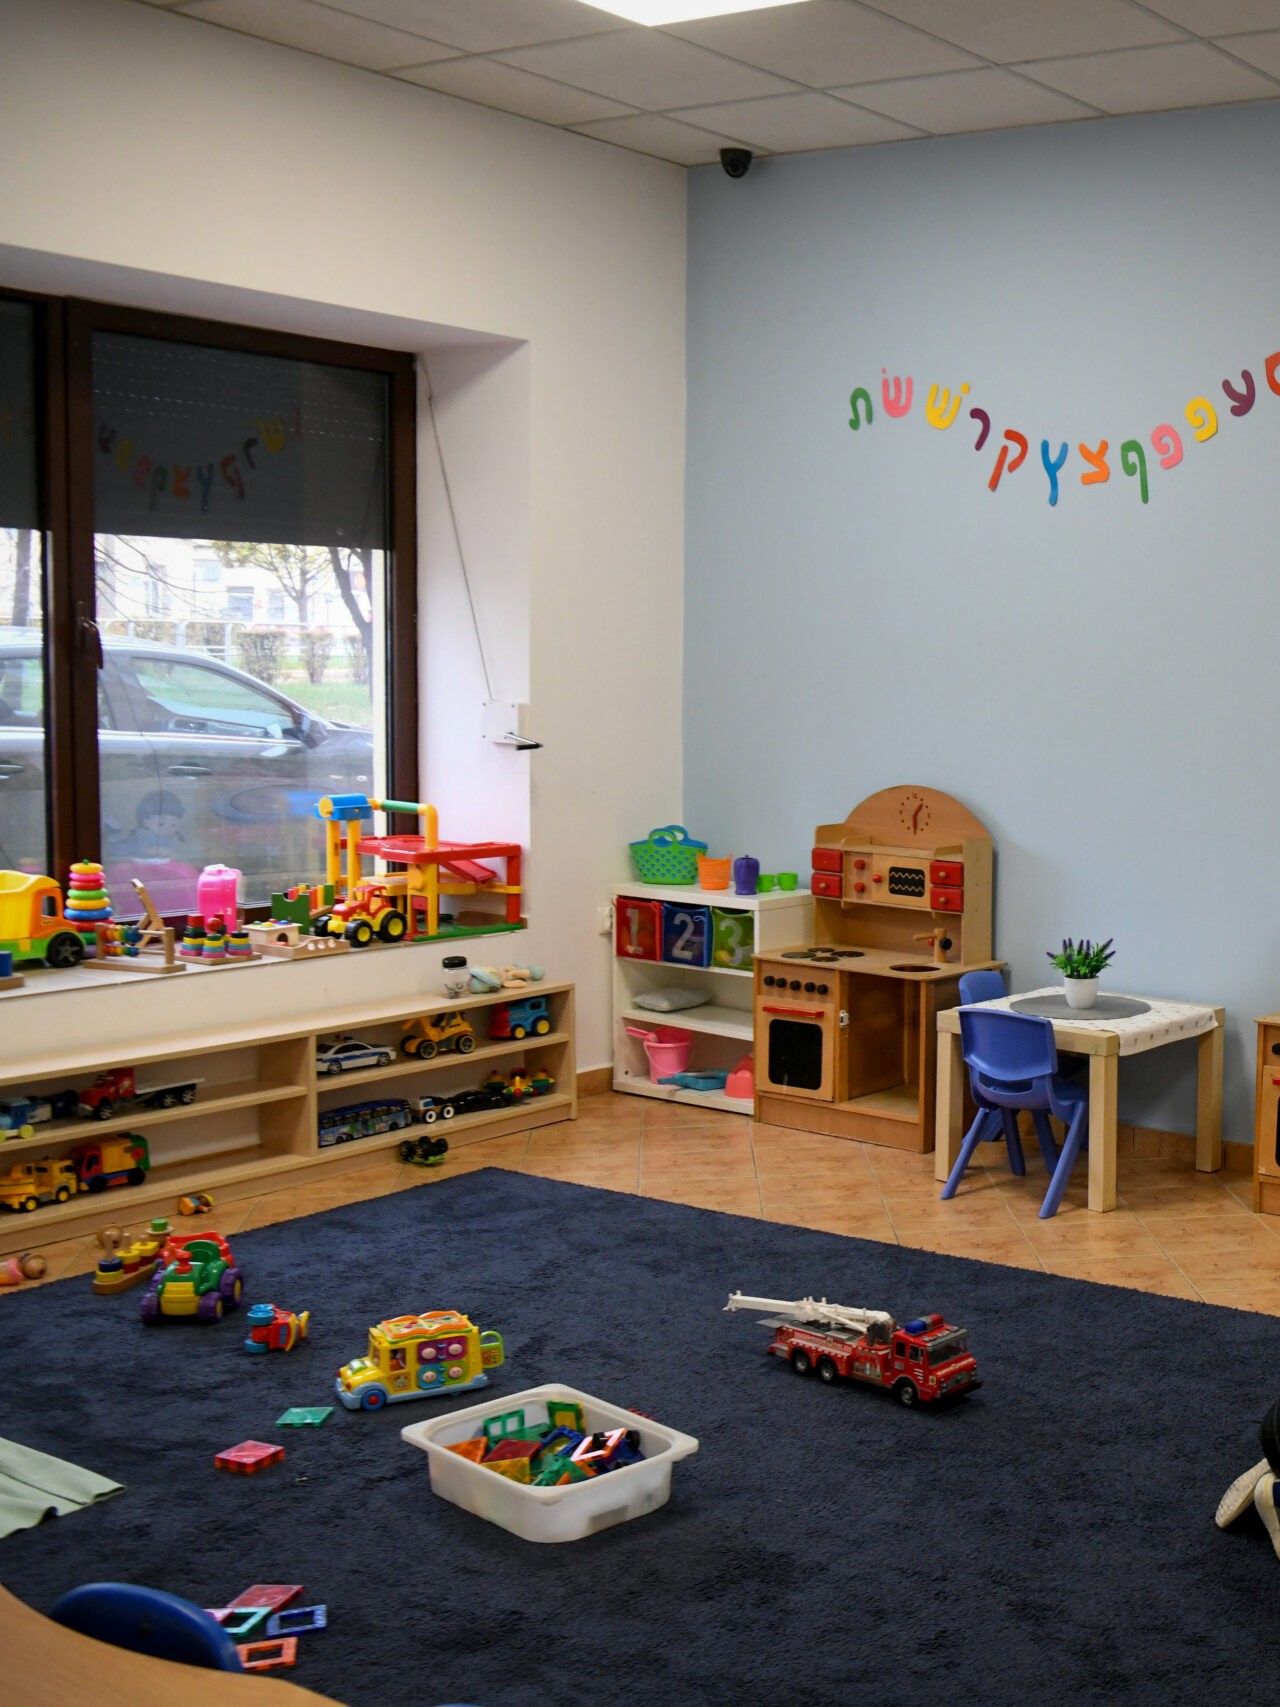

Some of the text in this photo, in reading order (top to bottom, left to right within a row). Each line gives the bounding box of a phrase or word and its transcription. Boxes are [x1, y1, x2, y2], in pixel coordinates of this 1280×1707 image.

[848, 386, 873, 431] ת
[1222, 369, 1256, 417] ע
[969, 407, 991, 451] ר
[987, 428, 1029, 491] ק
[1041, 439, 1069, 507] ץ
[1078, 438, 1111, 486] צ
[1120, 439, 1149, 504] ף
[626, 908, 643, 954] 1
[671, 913, 695, 960] 2
[719, 918, 743, 966] 3
